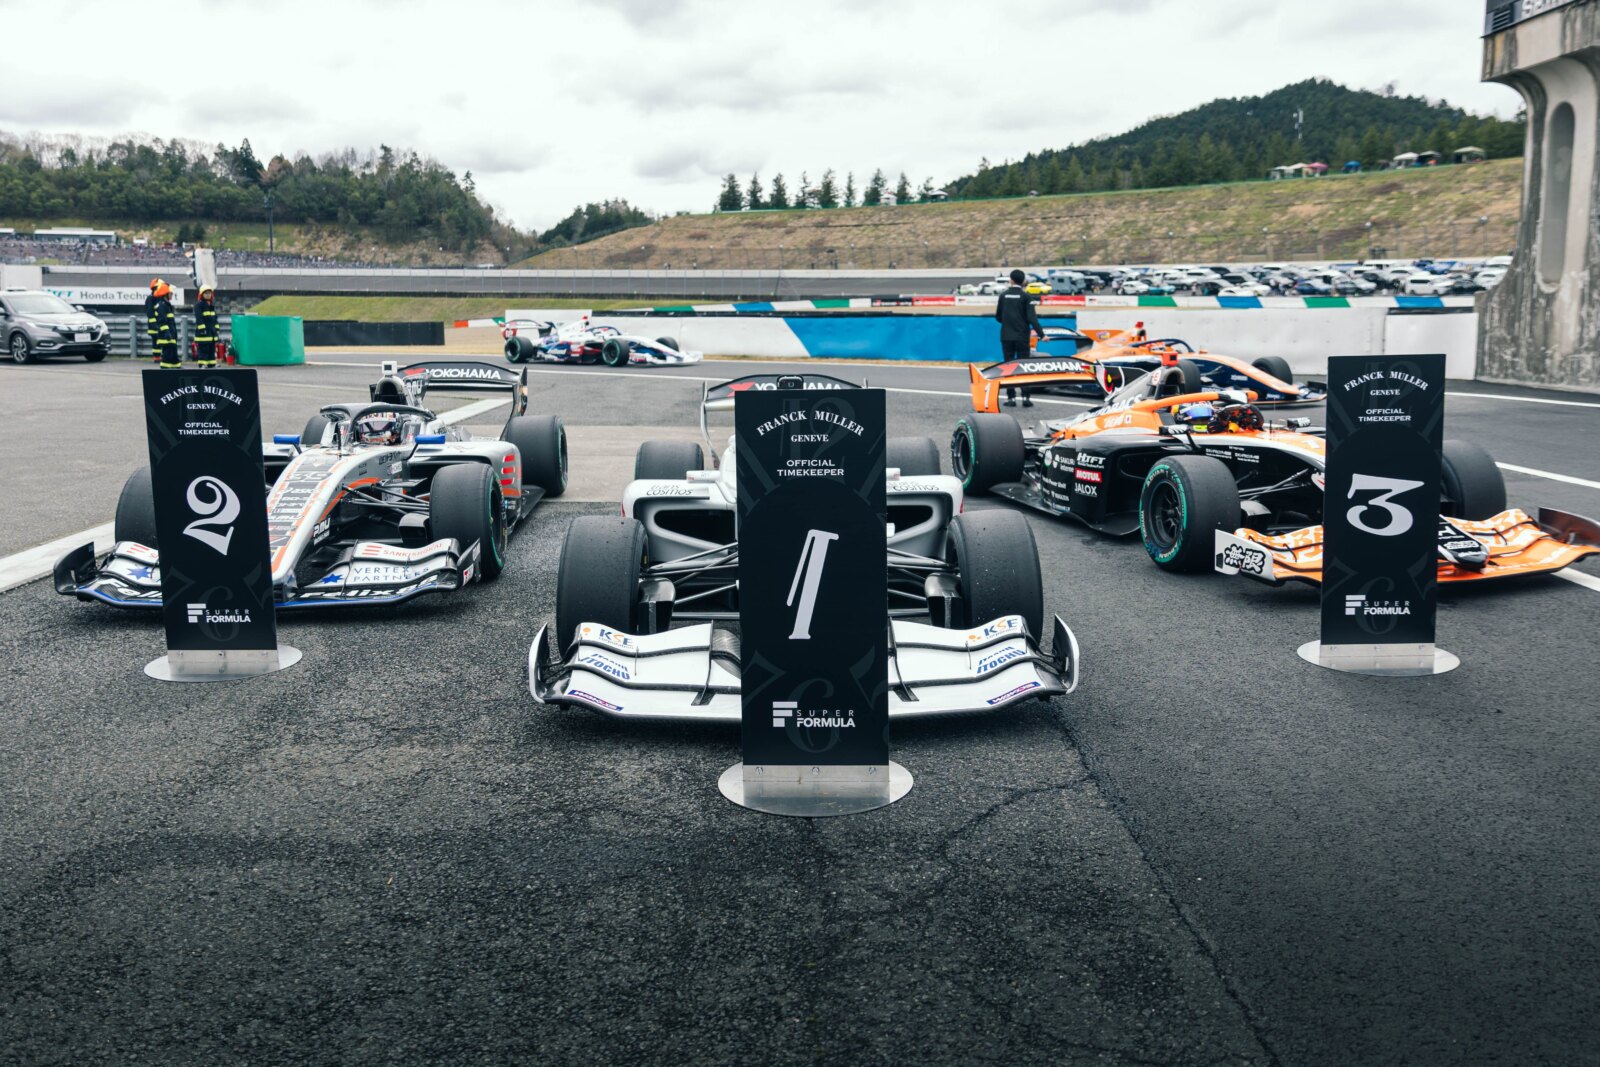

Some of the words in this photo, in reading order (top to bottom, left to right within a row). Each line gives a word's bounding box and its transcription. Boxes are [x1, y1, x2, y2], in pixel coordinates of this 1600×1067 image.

[80, 291, 115, 300] Honda
[425, 368, 501, 380] YOKOHAMA
[1344, 371, 1384, 391] FRANCK
[1389, 371, 1429, 391] MULLER
[160, 385, 199, 405] FRANCK
[203, 385, 242, 405] MULLER
[756, 410, 807, 436] FRANCK
[814, 410, 865, 436] MULLER
[790, 434, 829, 442] GENEVE
[786, 459, 836, 467] OFFICIAL
[1075, 469, 1101, 481] MOTUL
[1346, 473, 1425, 536] 3
[182, 475, 241, 556] 2
[354, 565, 411, 575] VERTEX
[786, 528, 840, 640] 1
[1364, 607, 1411, 615] FORMULA
[206, 615, 251, 623] FORMULA
[599, 628, 635, 646] KSE
[976, 650, 1029, 674] ITOCHU
[797, 709, 855, 717] SUPER
[797, 717, 856, 728] FORMULA
